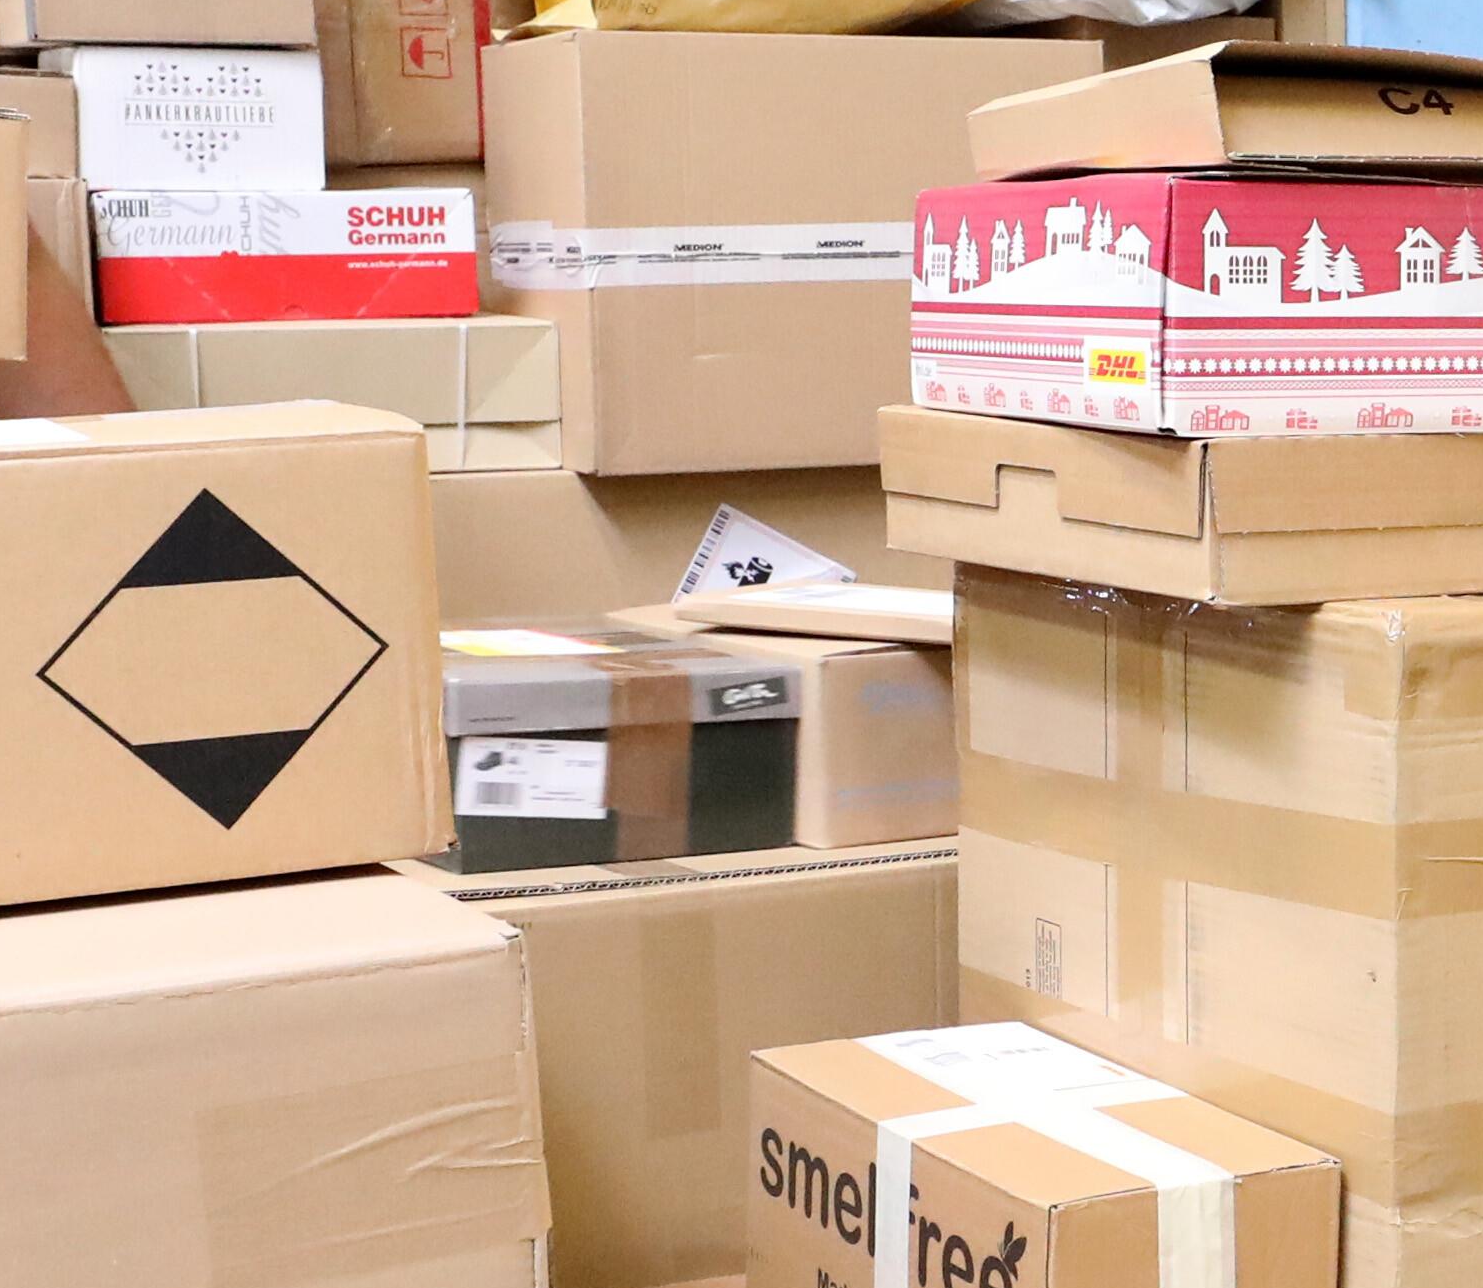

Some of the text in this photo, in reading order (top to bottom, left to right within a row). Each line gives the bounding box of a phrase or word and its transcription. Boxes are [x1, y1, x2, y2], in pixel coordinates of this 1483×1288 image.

[1378, 87, 1455, 116] C4
[124, 104, 276, 124] #ANKERKRAUTLIEBE
[347, 206, 446, 227] SCHUH
[347, 229, 447, 246] Germann
[1095, 354, 1139, 381] DHL
